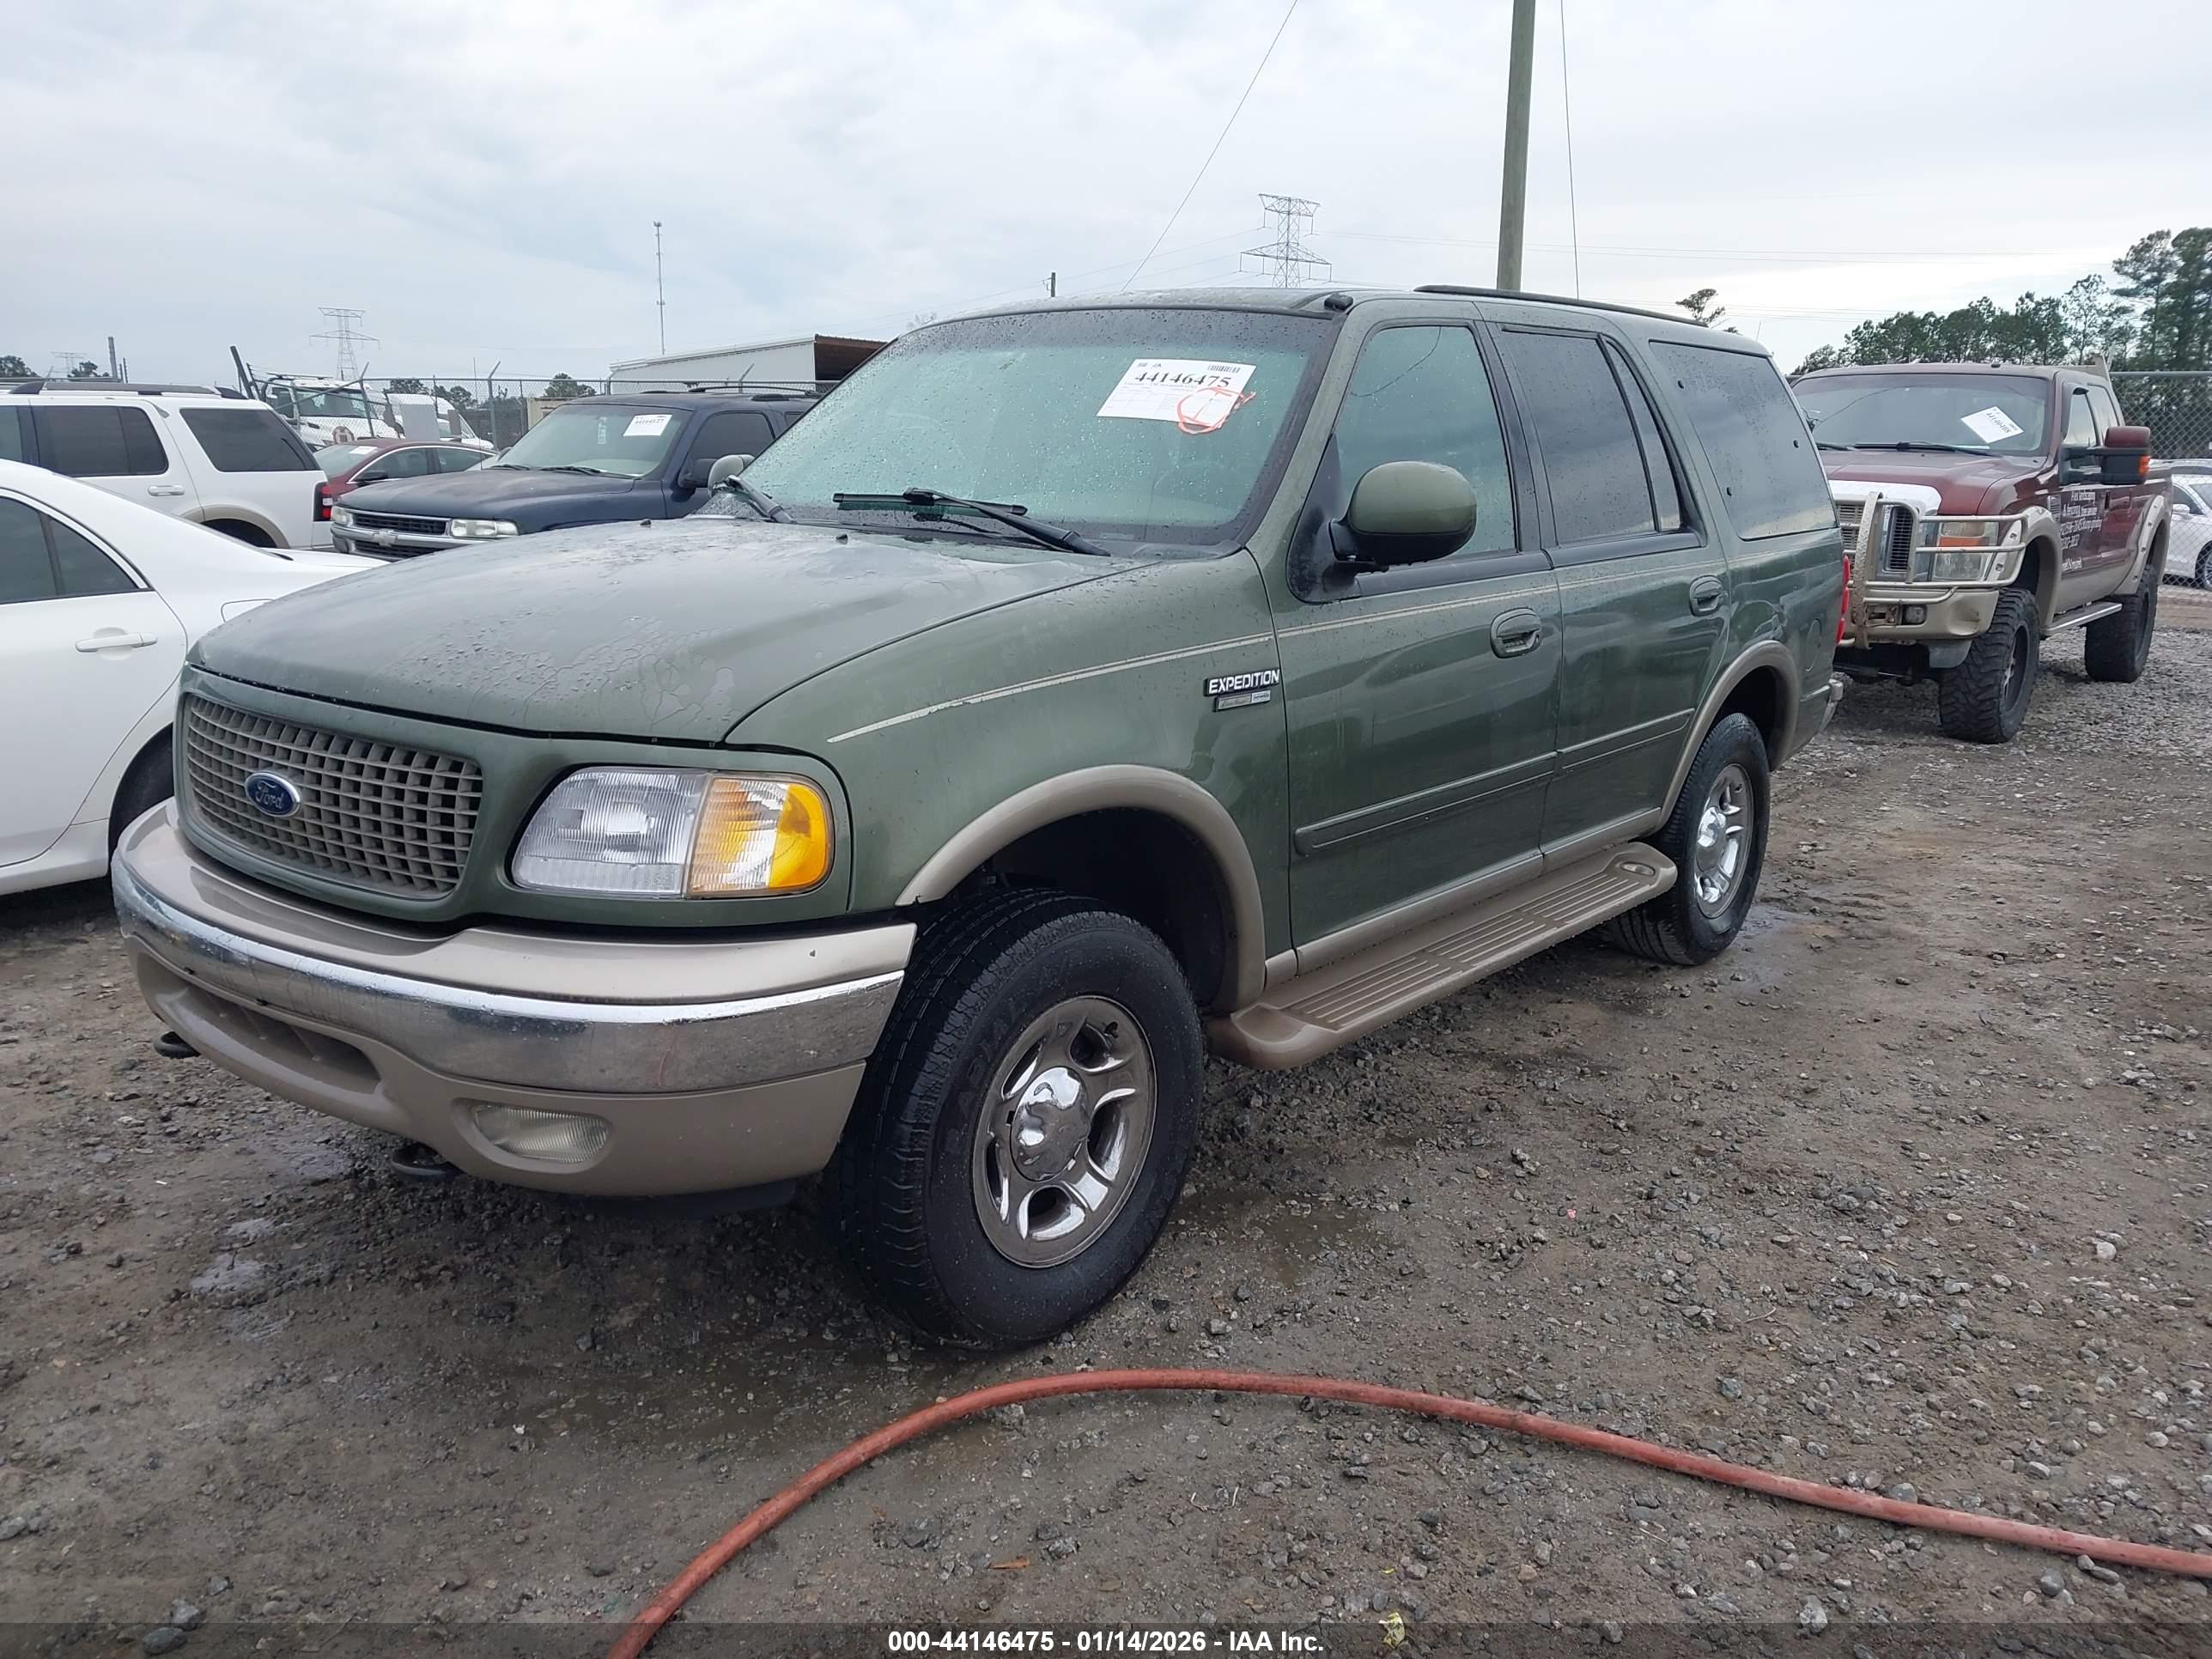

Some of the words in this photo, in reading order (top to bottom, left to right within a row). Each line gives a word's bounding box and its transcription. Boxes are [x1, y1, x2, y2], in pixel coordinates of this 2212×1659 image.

[1134, 371, 1232, 388] 44146475
[1208, 668, 1280, 695] EXPEDITION
[254, 780, 284, 810] Ford
